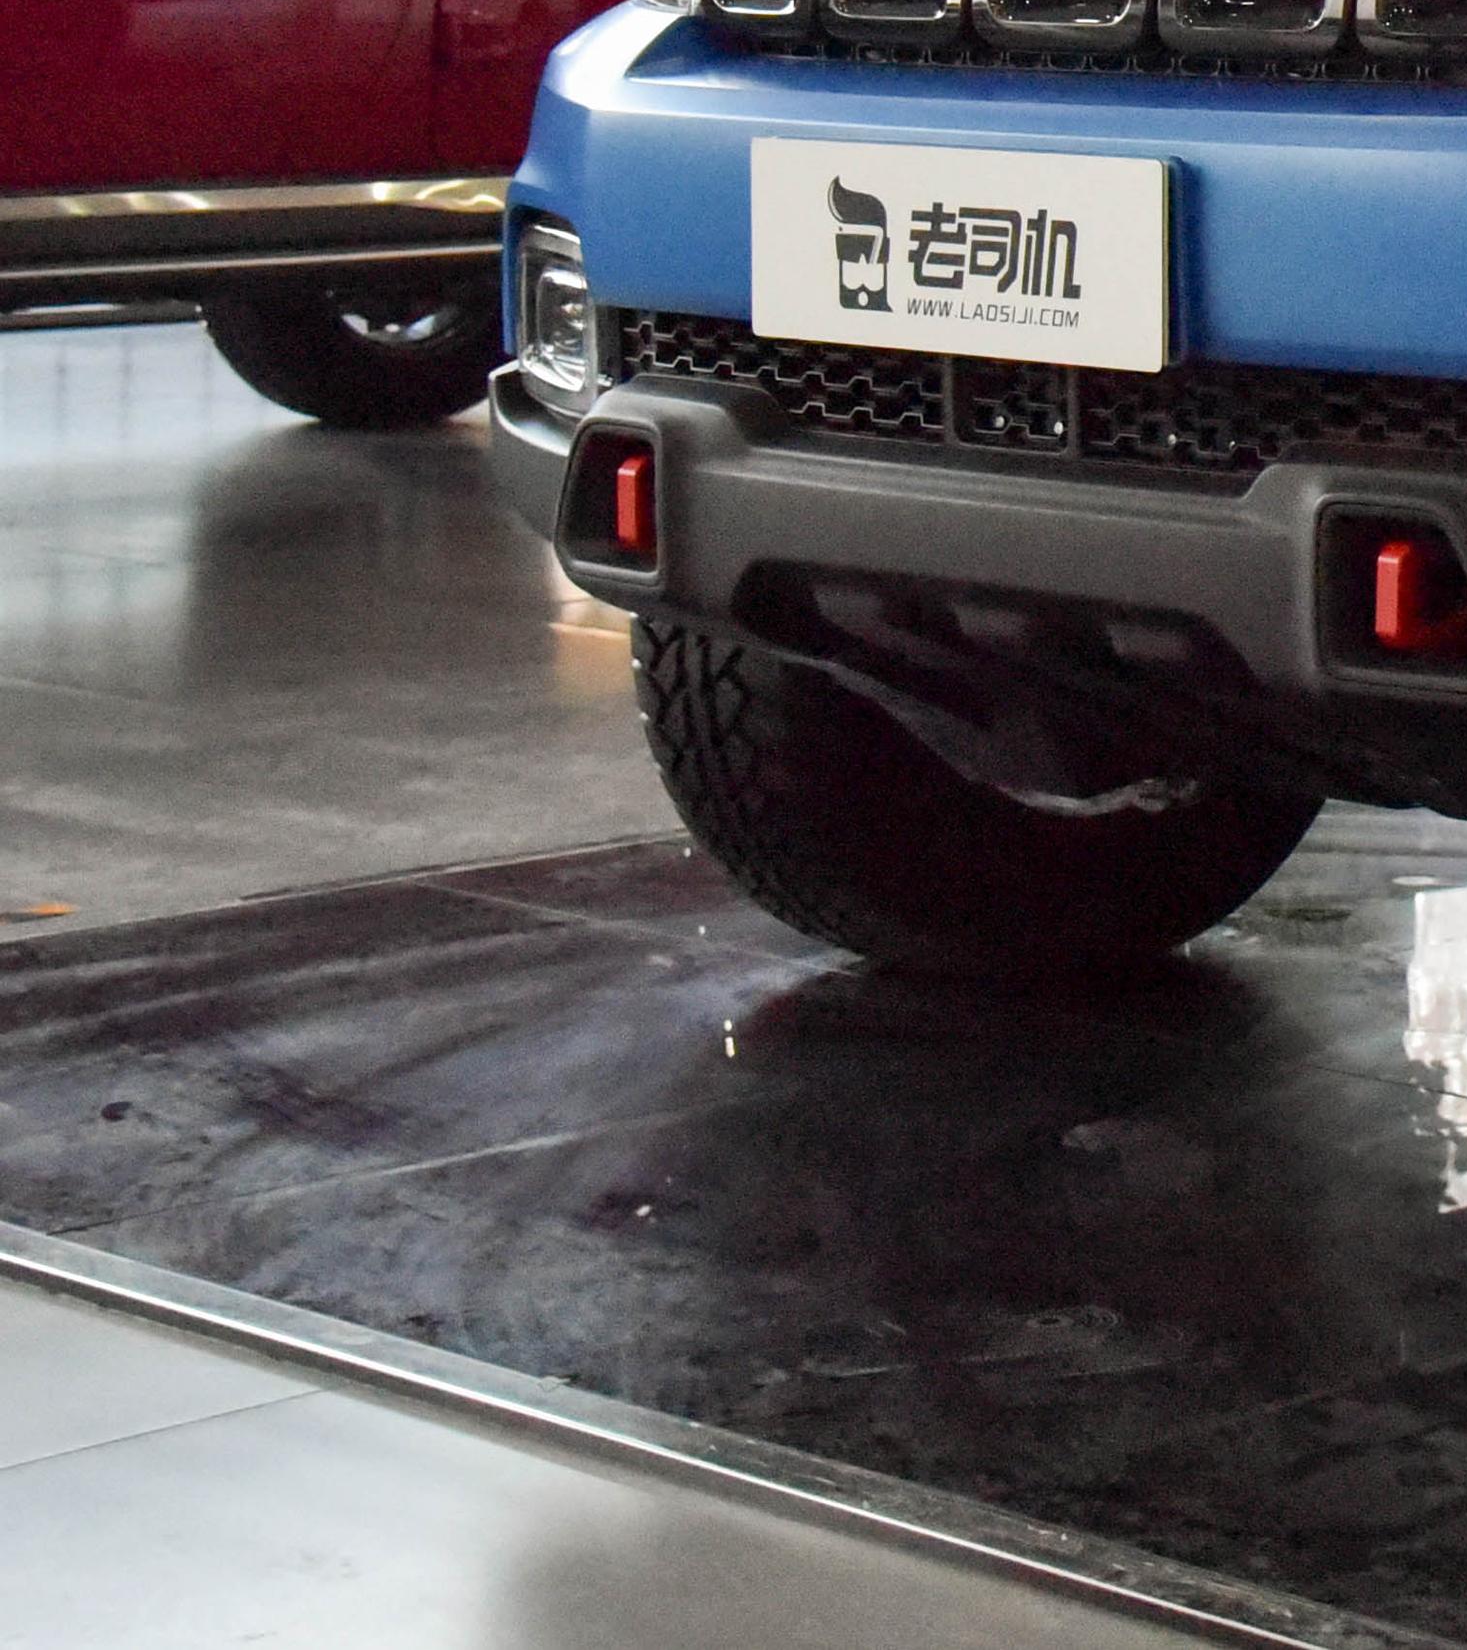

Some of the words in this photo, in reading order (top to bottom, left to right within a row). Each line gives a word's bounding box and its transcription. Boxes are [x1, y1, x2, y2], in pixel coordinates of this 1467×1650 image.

[907, 202, 1082, 299] 老司机
[906, 298, 1081, 329] WWW.LAOSIJI.COM
